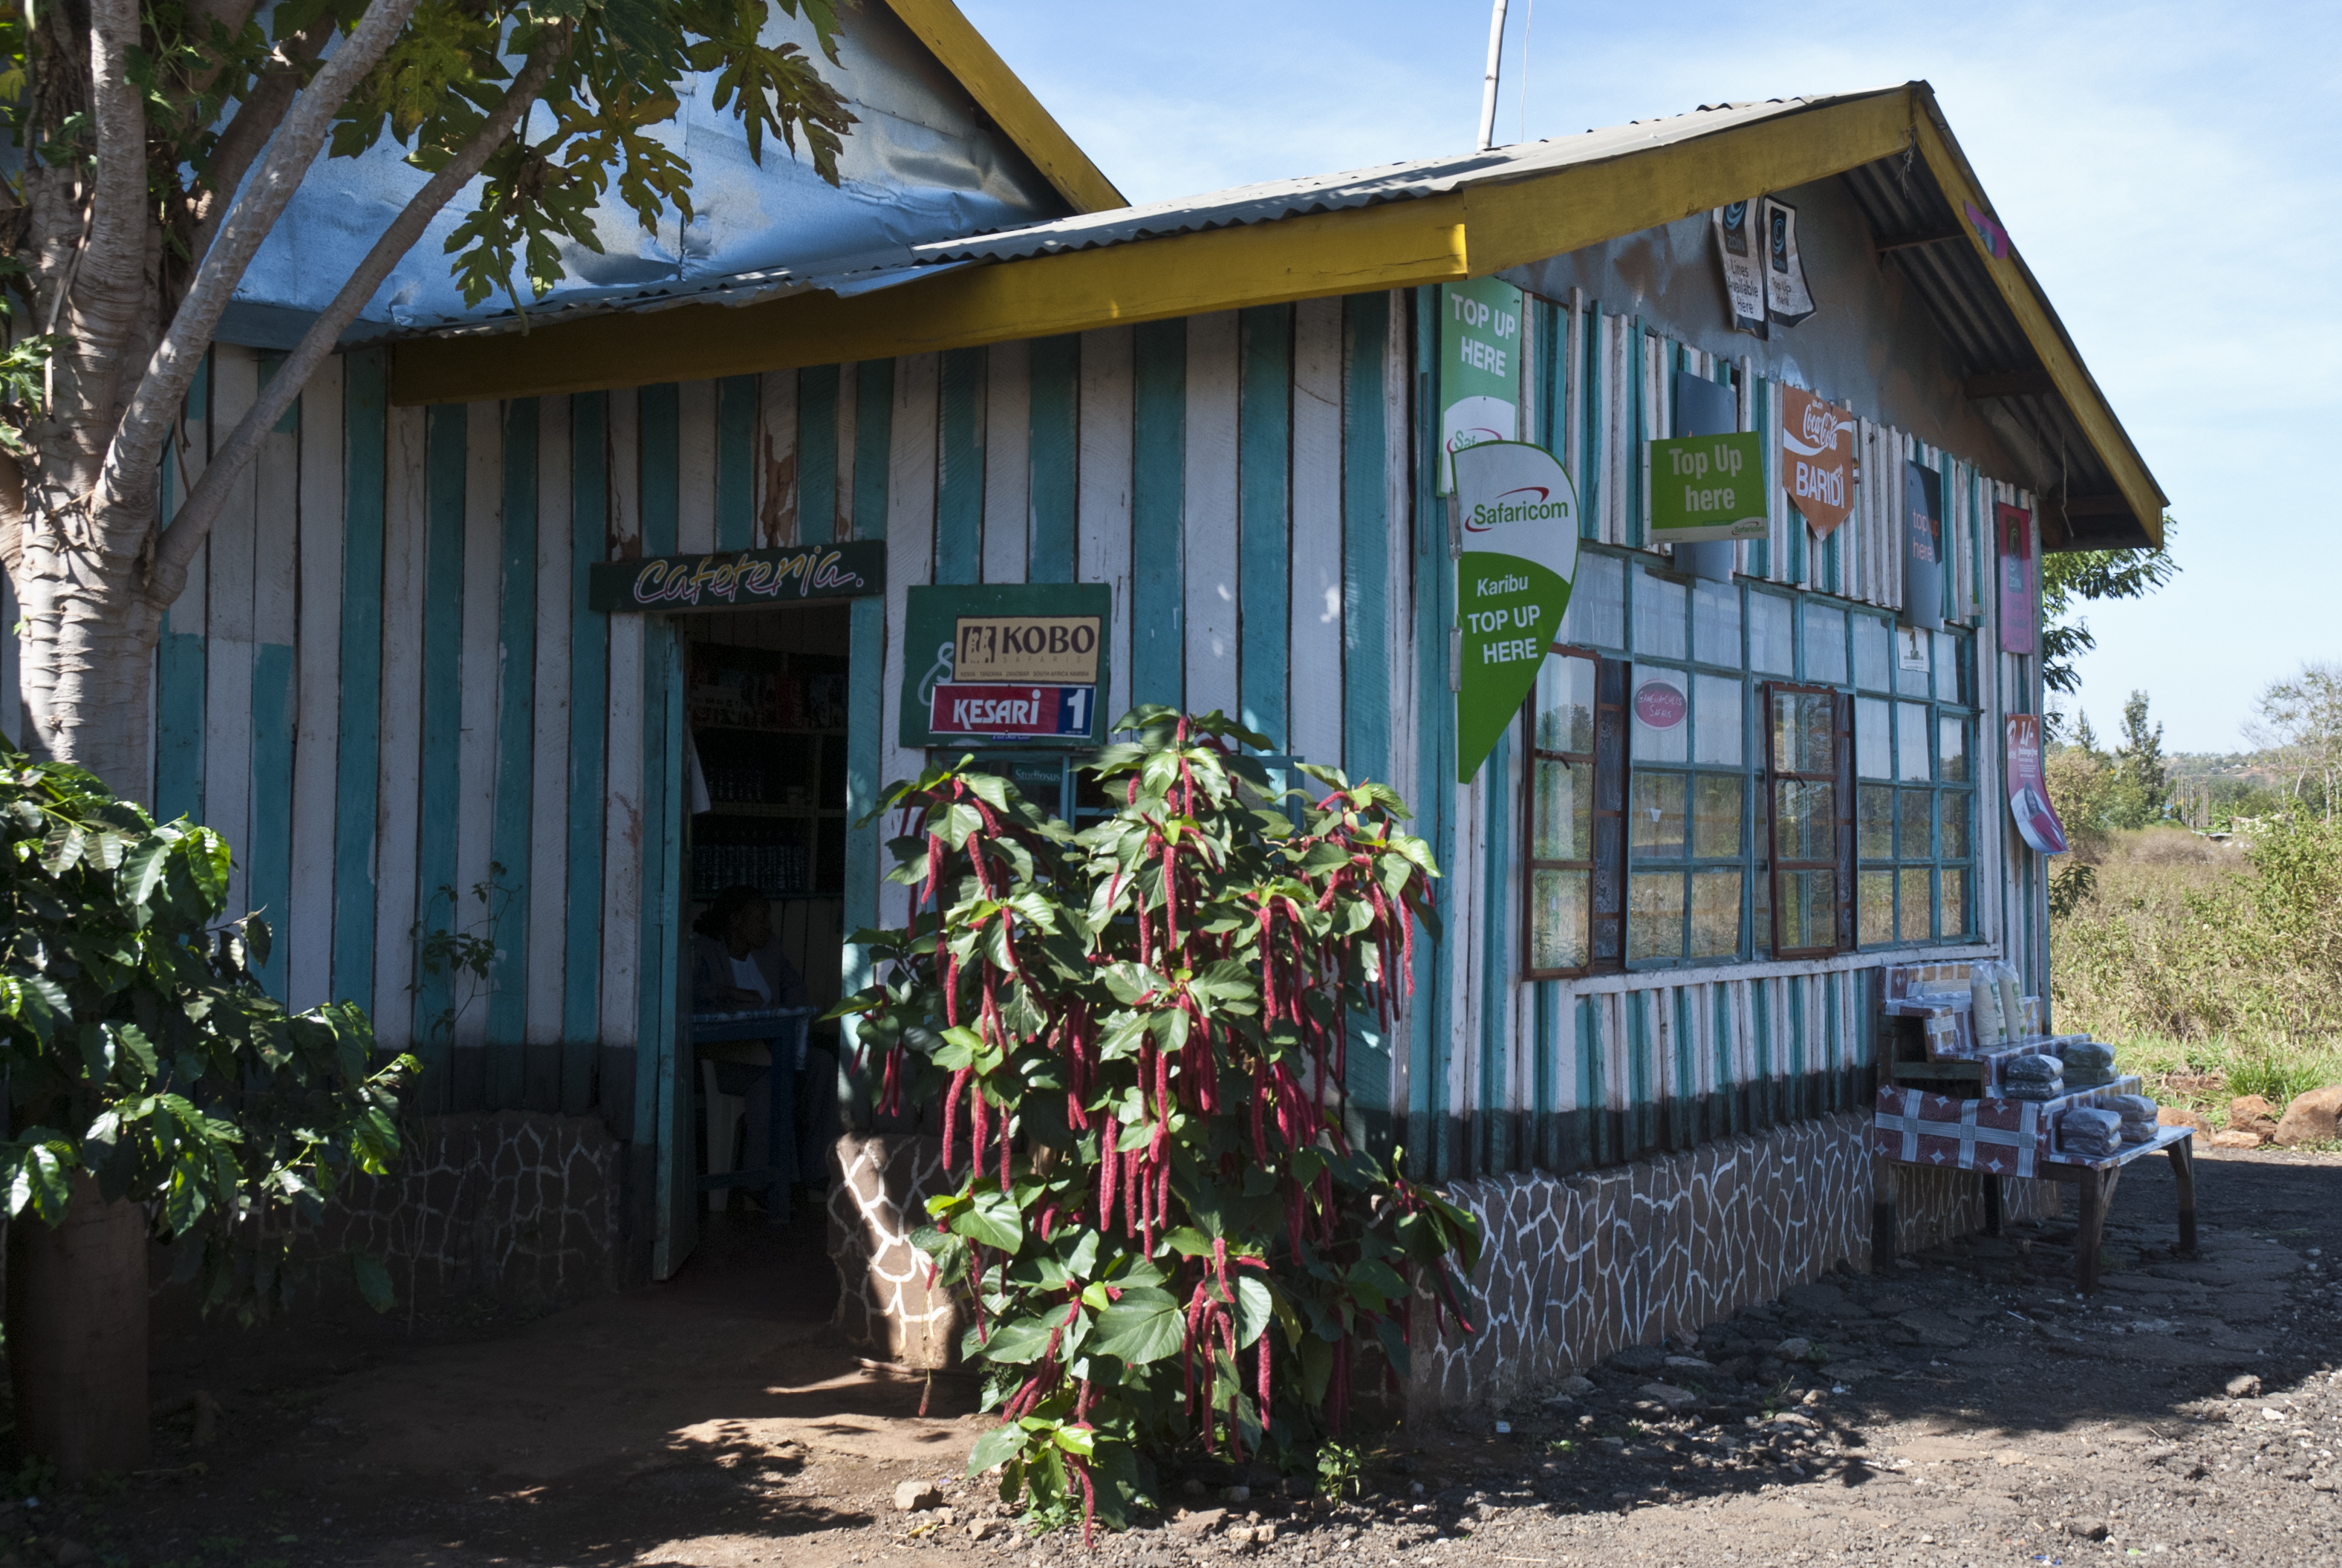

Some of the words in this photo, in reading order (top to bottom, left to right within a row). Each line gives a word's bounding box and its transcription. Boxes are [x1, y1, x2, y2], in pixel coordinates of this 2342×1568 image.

[1730, 258, 1749, 277] Lines
[1727, 276, 1759, 297] Available
[1451, 293, 1489, 328] TOP
[1494, 309, 1516, 339] UP
[1736, 296, 1754, 313] Here
[1460, 336, 1506, 377] HERE
[1803, 403, 1838, 450] Coca-Cola
[1668, 447, 1708, 479] Top
[1714, 444, 1743, 477] Up
[1795, 461, 1844, 508] BARIDI
[1685, 485, 1735, 512] here
[1474, 501, 1569, 525] Safaricom
[1912, 508, 1928, 536] top
[1929, 518, 1939, 541] up
[1734, 524, 1765, 533] Safaricom
[1913, 536, 1933, 562] here
[1477, 573, 1529, 596] Karibu
[1468, 610, 1509, 634] TOP
[1513, 605, 1541, 628] UP
[1001, 625, 1096, 654] KOBO
[1483, 637, 1538, 664] HERE
[1003, 655, 1081, 663] SAFARIS
[1067, 689, 1086, 729] 1
[1015, 768, 1061, 781] Studiosus
